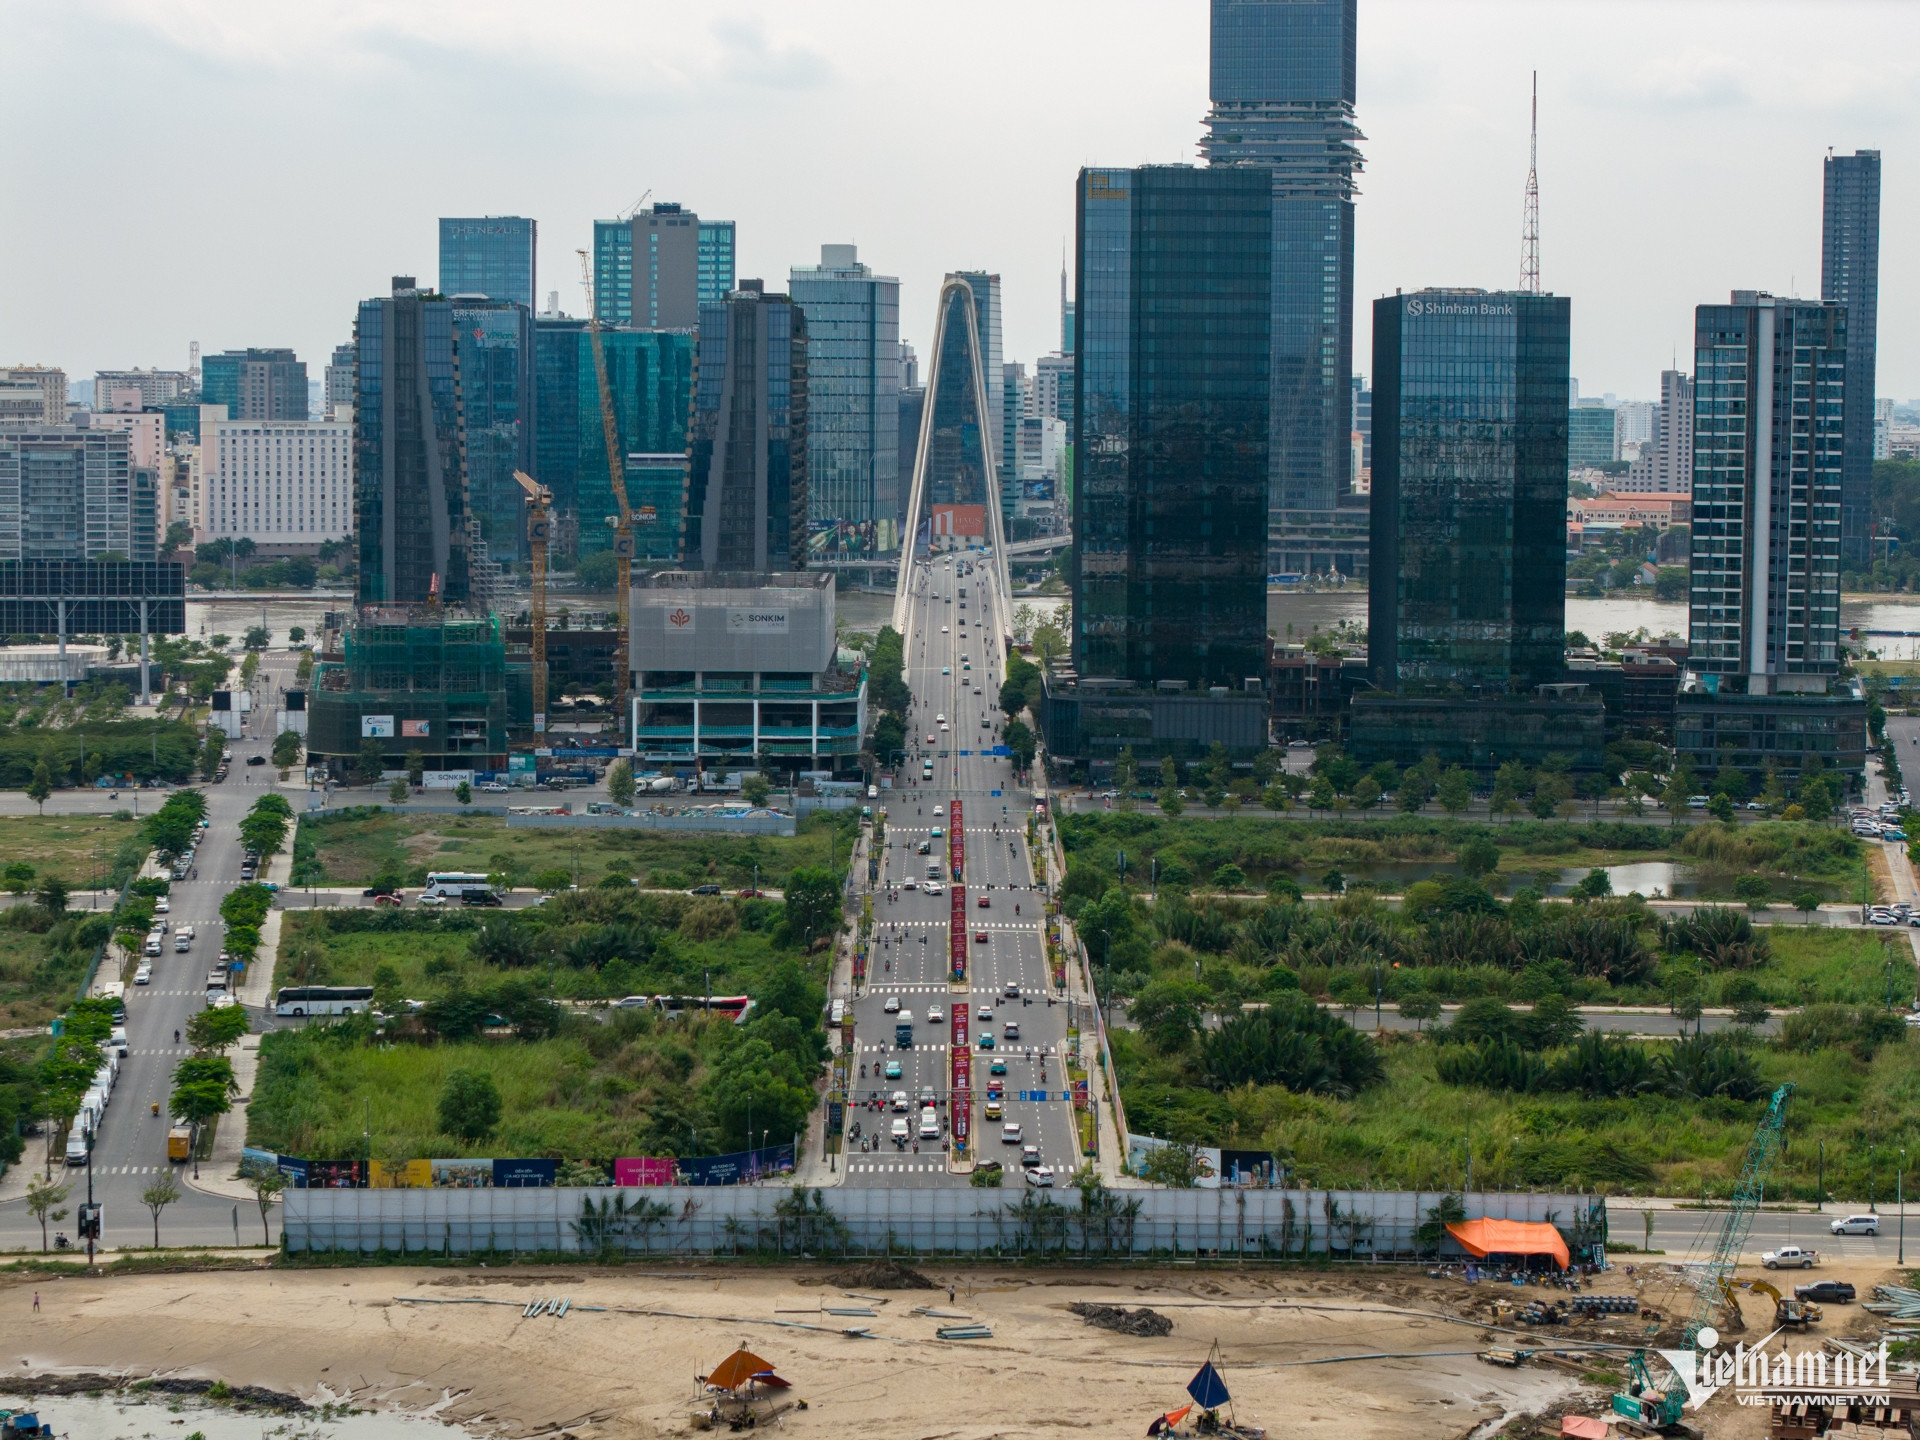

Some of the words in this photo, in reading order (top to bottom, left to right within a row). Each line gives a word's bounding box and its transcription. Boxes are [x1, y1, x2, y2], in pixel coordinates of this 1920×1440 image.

[478, 226, 520, 234] NEXUS
[1425, 302, 1477, 315] Shinhan
[1480, 303, 1512, 315] Bank
[631, 513, 656, 521] SONKIM
[748, 614, 785, 622] SONKIM
